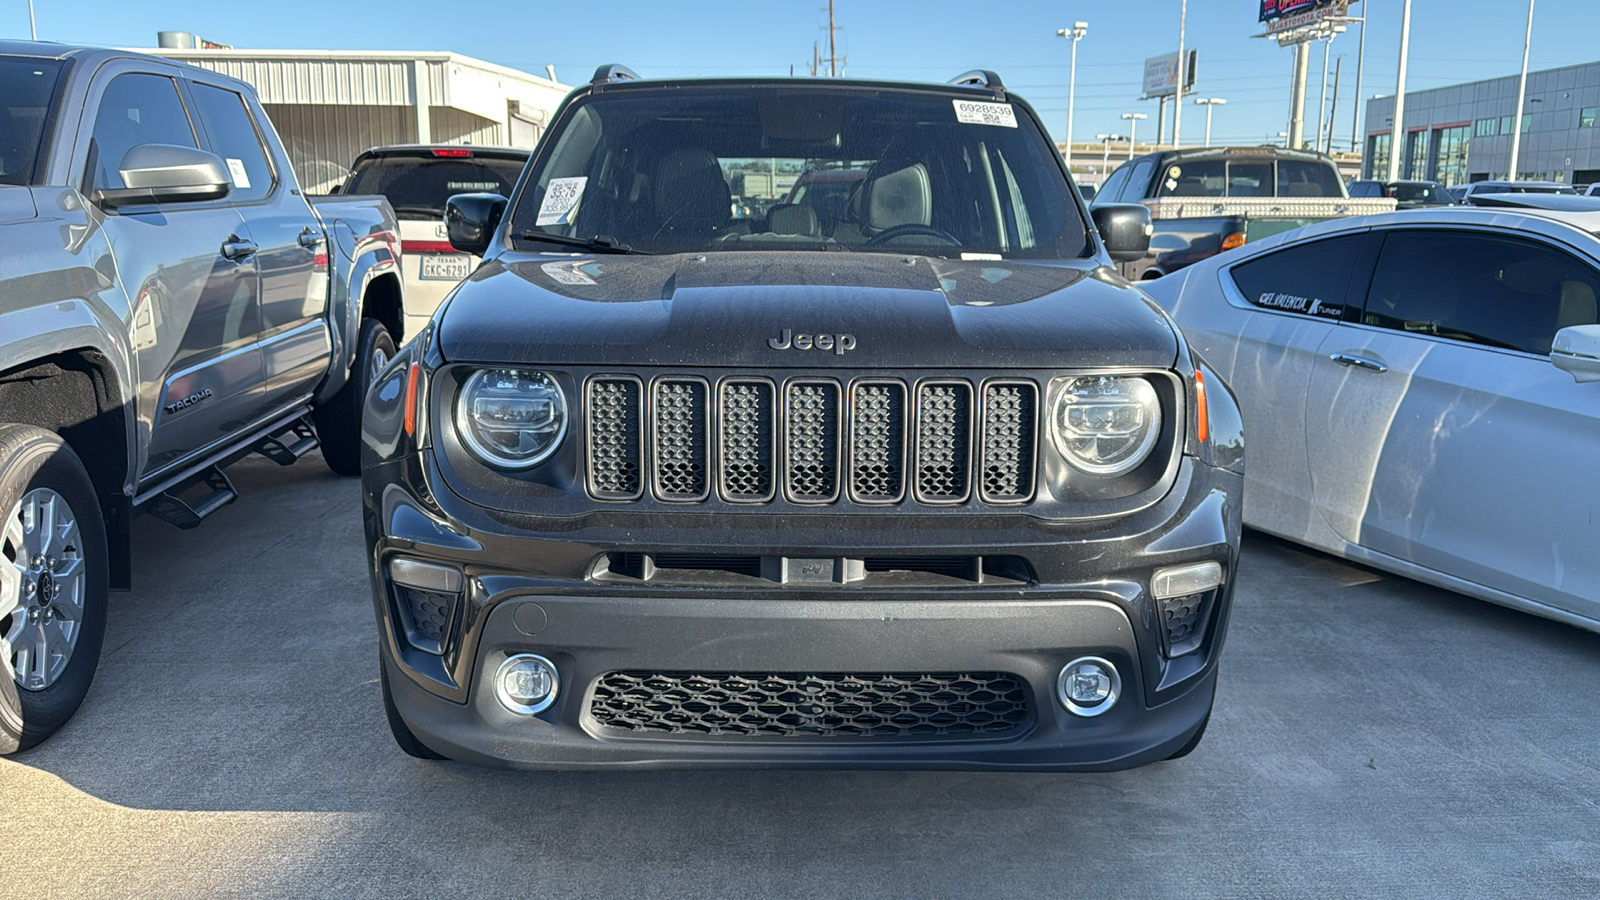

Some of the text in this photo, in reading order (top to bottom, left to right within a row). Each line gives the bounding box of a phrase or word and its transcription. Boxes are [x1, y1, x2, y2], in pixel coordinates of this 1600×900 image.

[959, 103, 1012, 116] 6928539
[767, 328, 857, 355] Jeep
[165, 388, 213, 414] TACOMA
